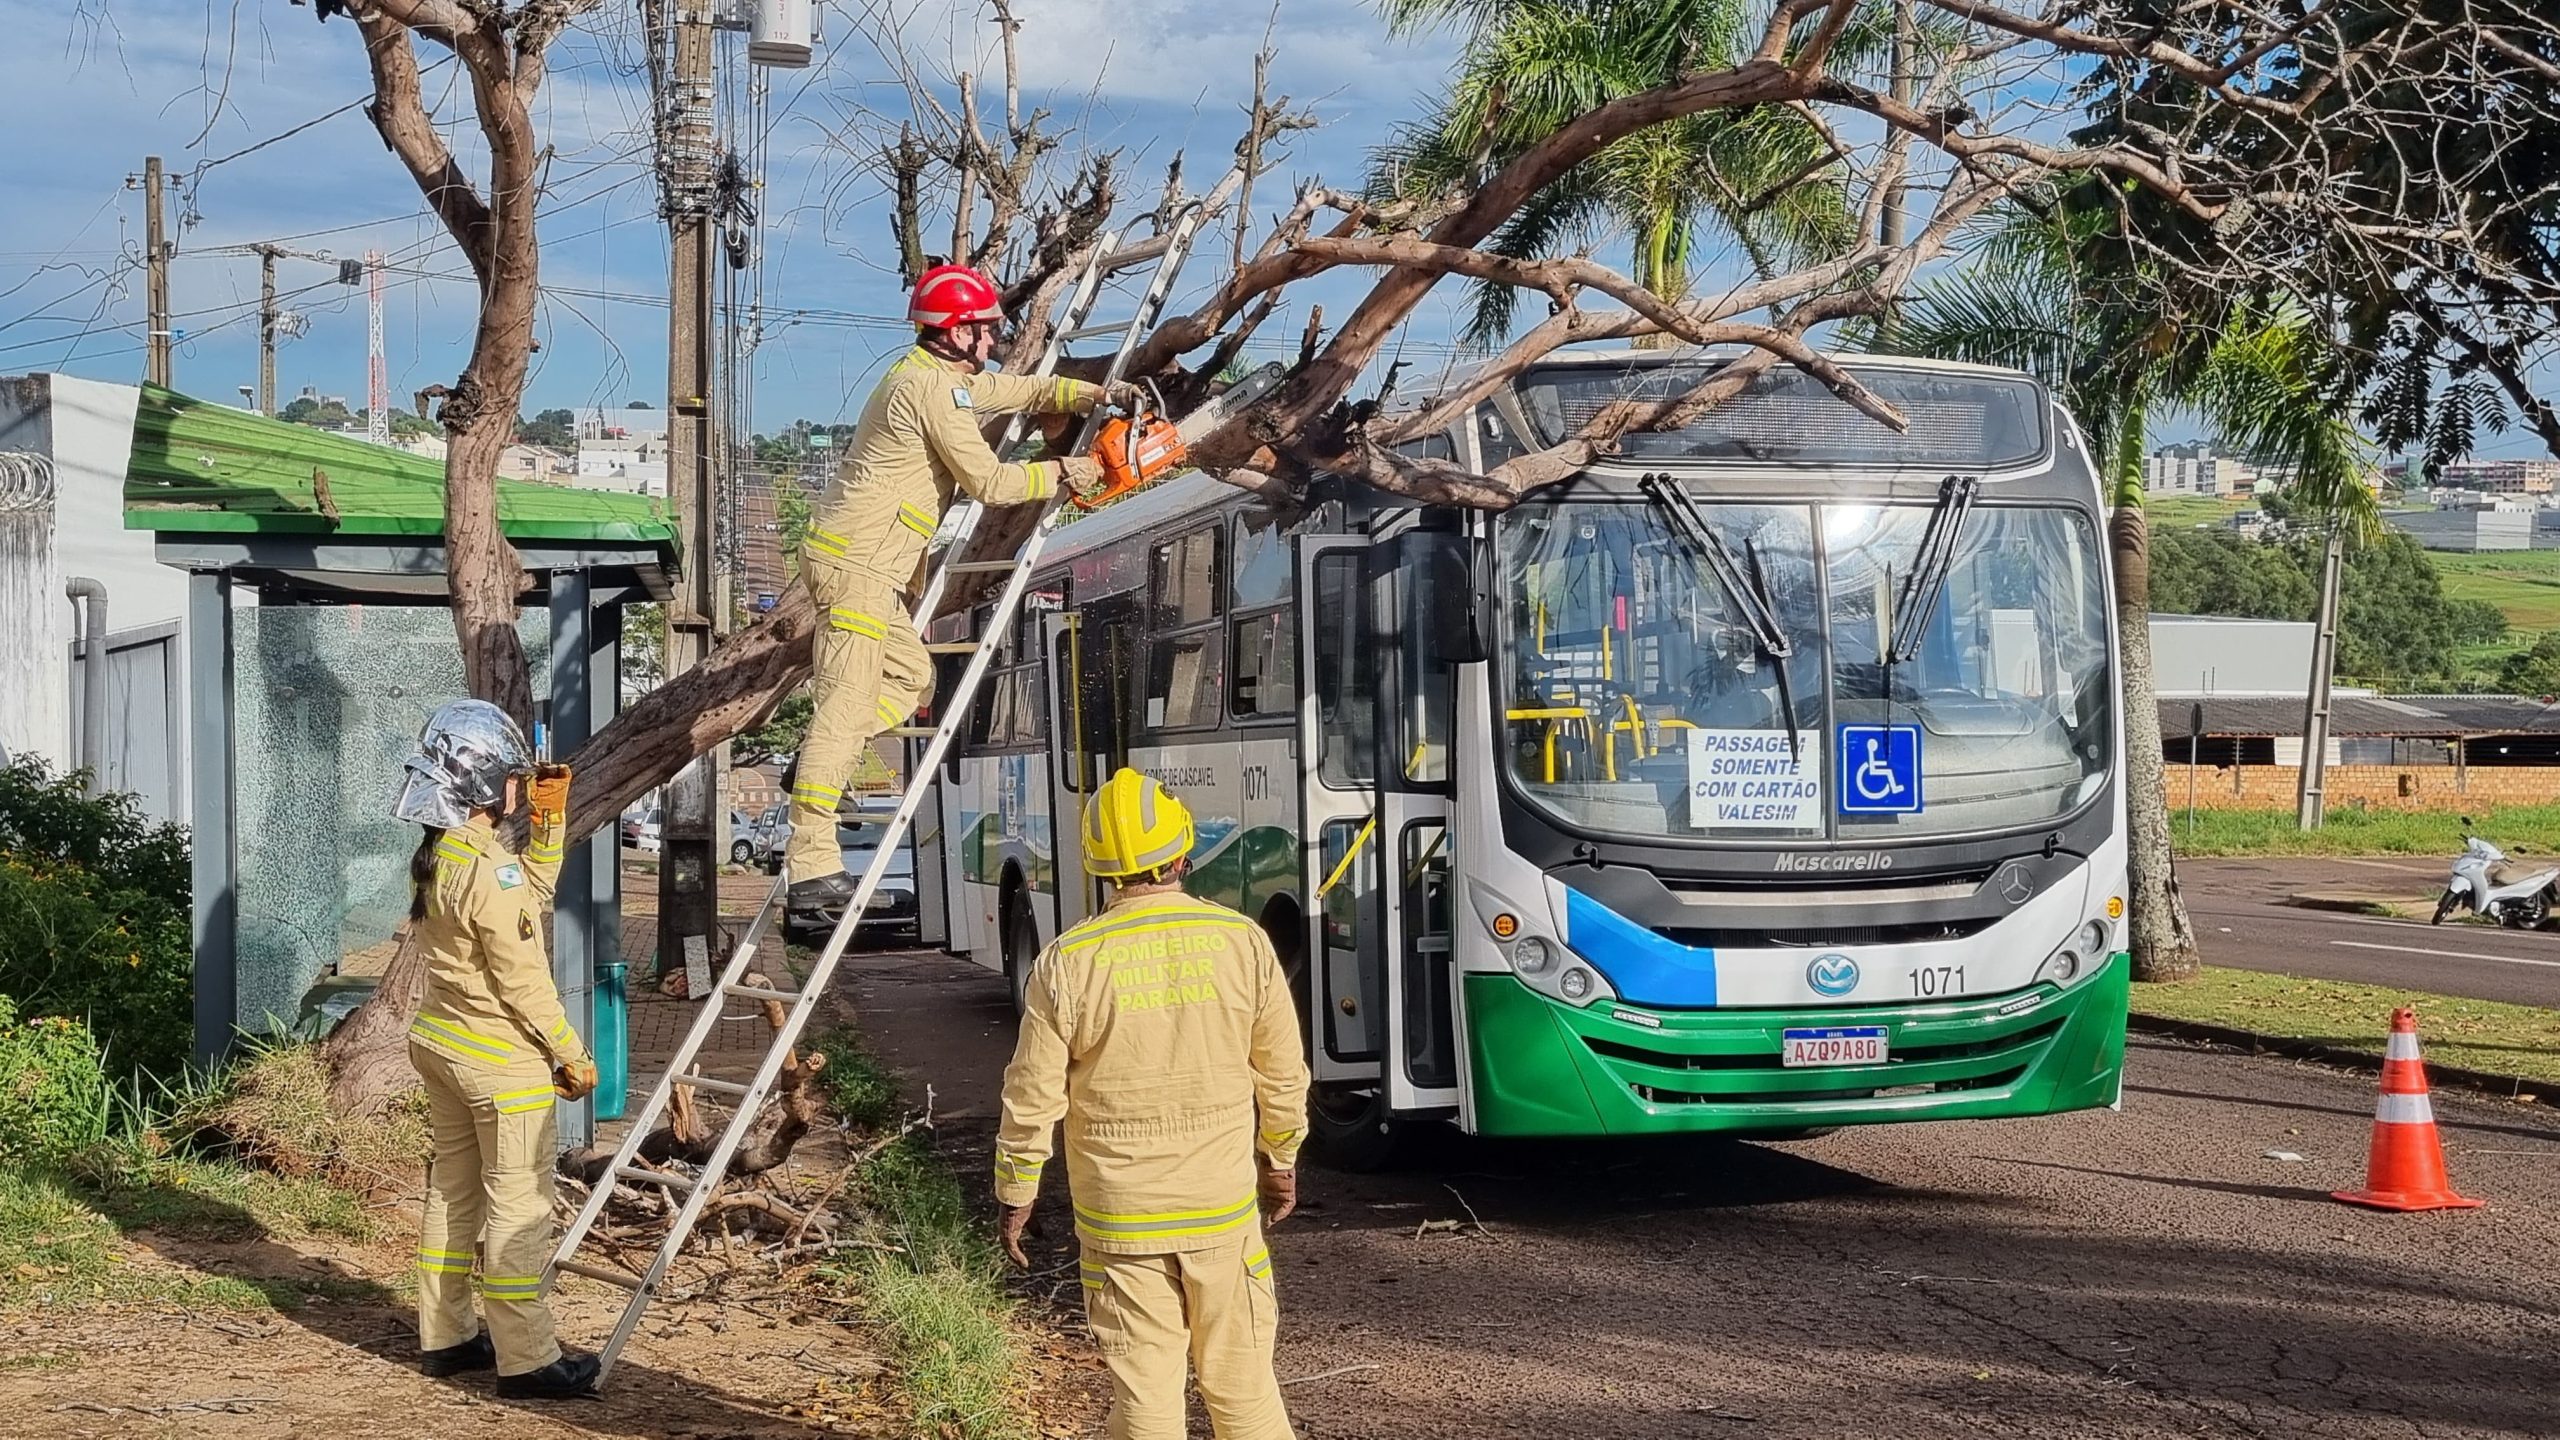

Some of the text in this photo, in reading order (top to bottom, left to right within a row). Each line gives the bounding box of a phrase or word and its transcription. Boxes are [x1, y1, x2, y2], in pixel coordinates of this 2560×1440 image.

[774, 31, 789, 40] 112
[1207, 389, 1248, 418] Toyama
[1169, 768, 1178, 787] DE
[1179, 766, 1216, 787] CASCAVEL
[1711, 759, 1801, 776] SOMENTE
[1243, 765, 1268, 800] 1071
[1695, 779, 1817, 799] COM CARTÃO
[1718, 804, 1798, 821] VALESIM
[1774, 852, 1893, 873] Mascarello
[1094, 934, 1227, 969] BOMBEIRO
[1112, 958, 1215, 989] MILITAR
[1909, 965, 1966, 997] 1071
[1118, 979, 1218, 1014] PARANÁ
